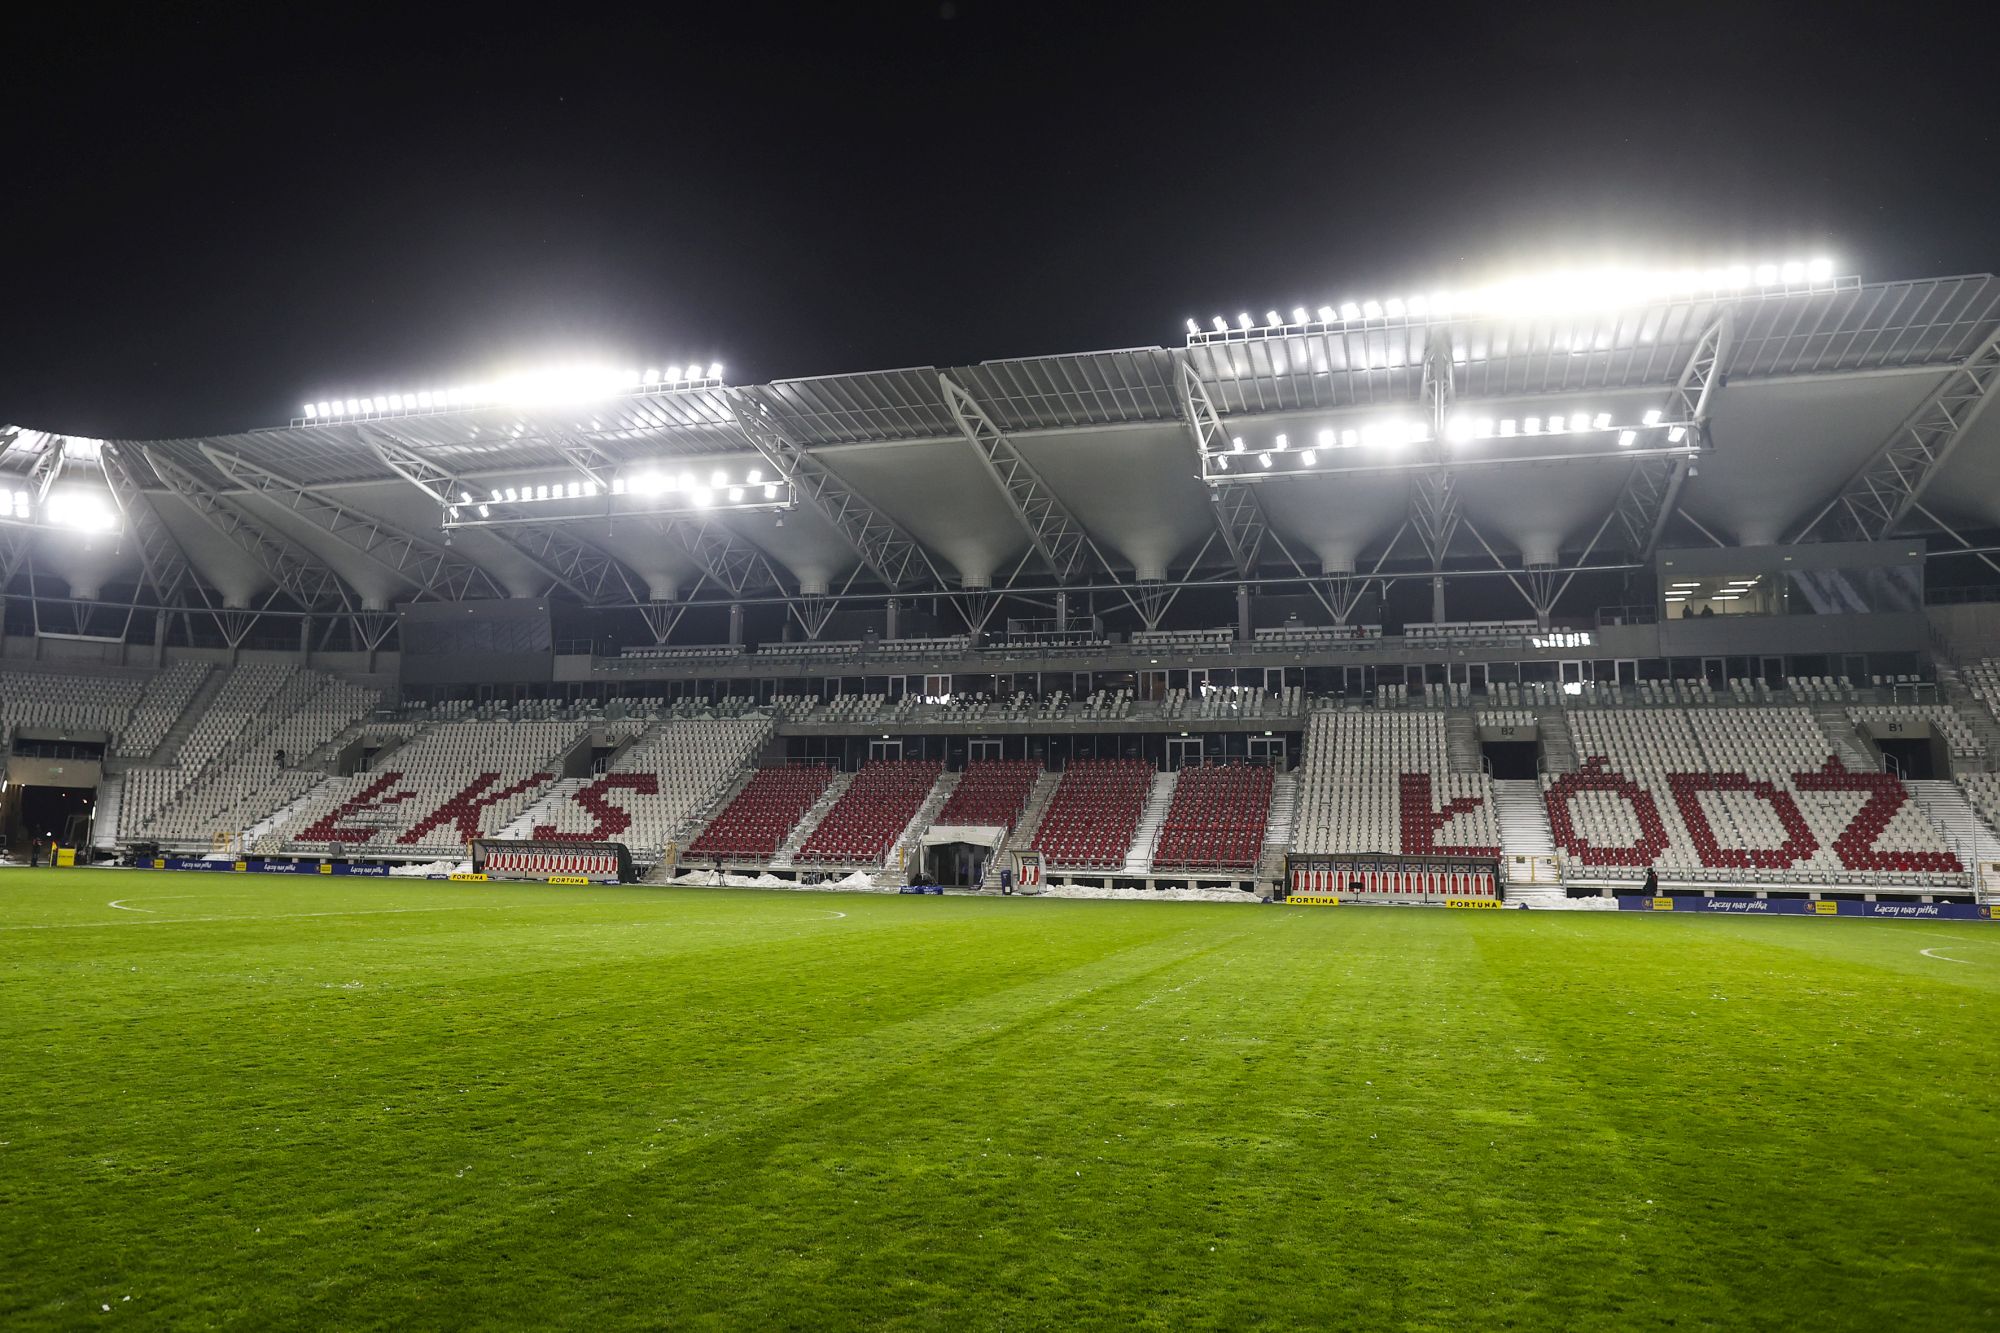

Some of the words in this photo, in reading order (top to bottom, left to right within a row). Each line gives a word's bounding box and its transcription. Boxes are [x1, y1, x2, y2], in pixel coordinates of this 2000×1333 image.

[1501, 727, 1515, 736] B2
[1889, 723, 1903, 732] B1
[1290, 897, 1335, 905] FORTUNA
[1708, 899, 1731, 910] Łączy
[1732, 901, 1747, 909] nas
[1746, 901, 1768, 911] piłka
[1874, 904, 1899, 915] Łączy
[1900, 906, 1917, 914] nas
[1915, 905, 1938, 916] piłka
